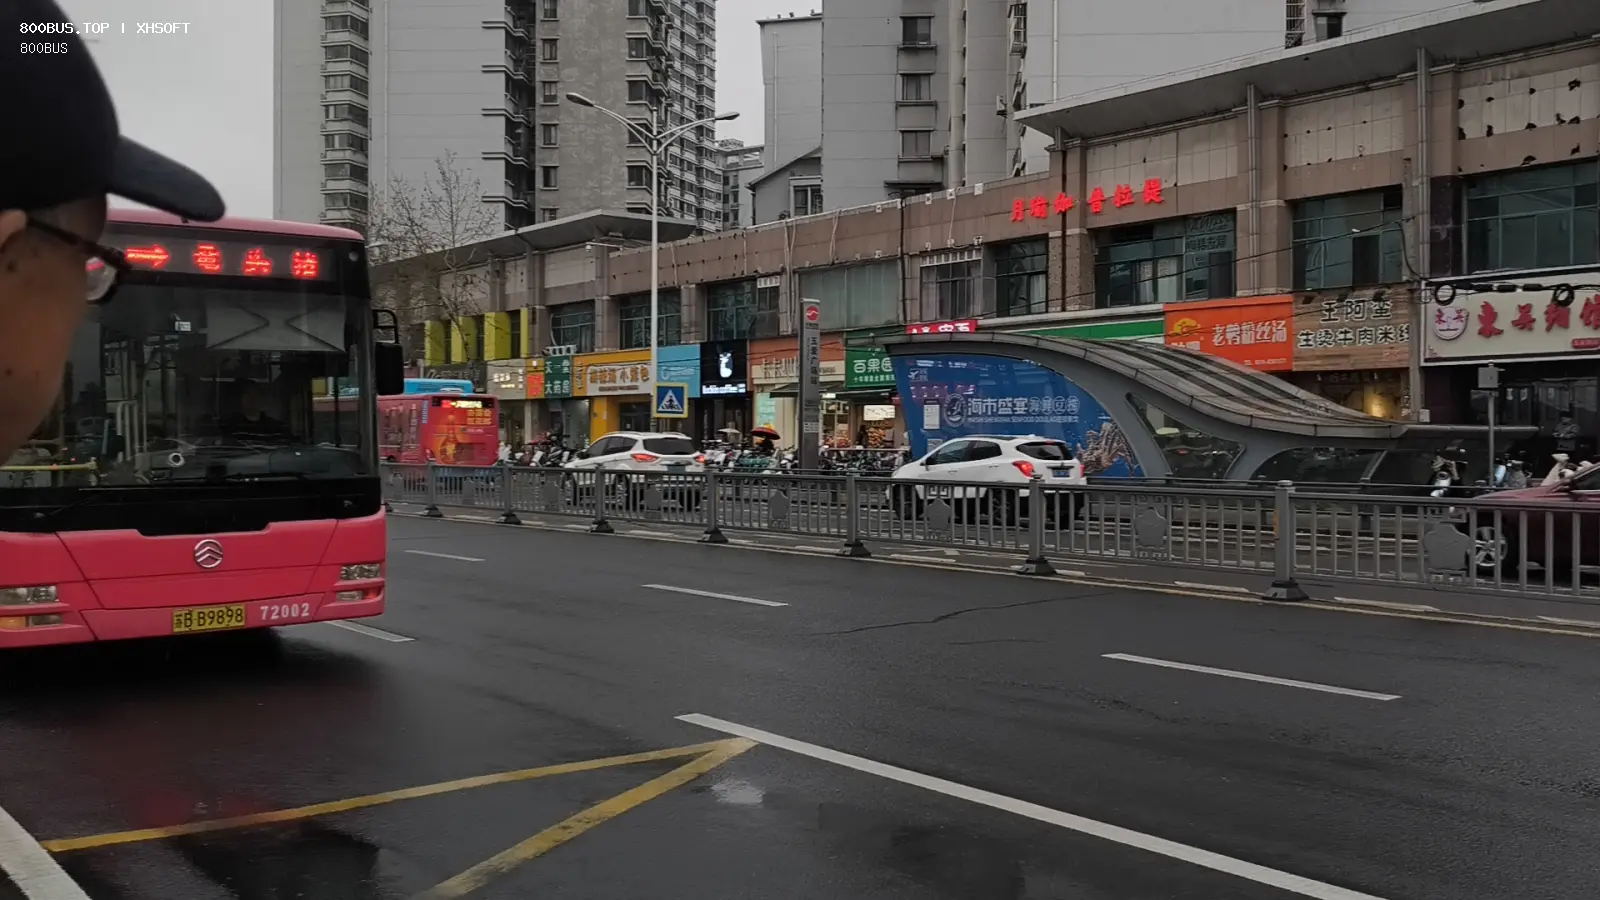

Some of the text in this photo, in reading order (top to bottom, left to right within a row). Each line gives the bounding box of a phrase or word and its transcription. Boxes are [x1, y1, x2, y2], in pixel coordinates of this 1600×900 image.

[852, 357, 894, 374] 百果园
[967, 397, 1029, 416] 海市盛宴
[260, 602, 310, 621] 72002
